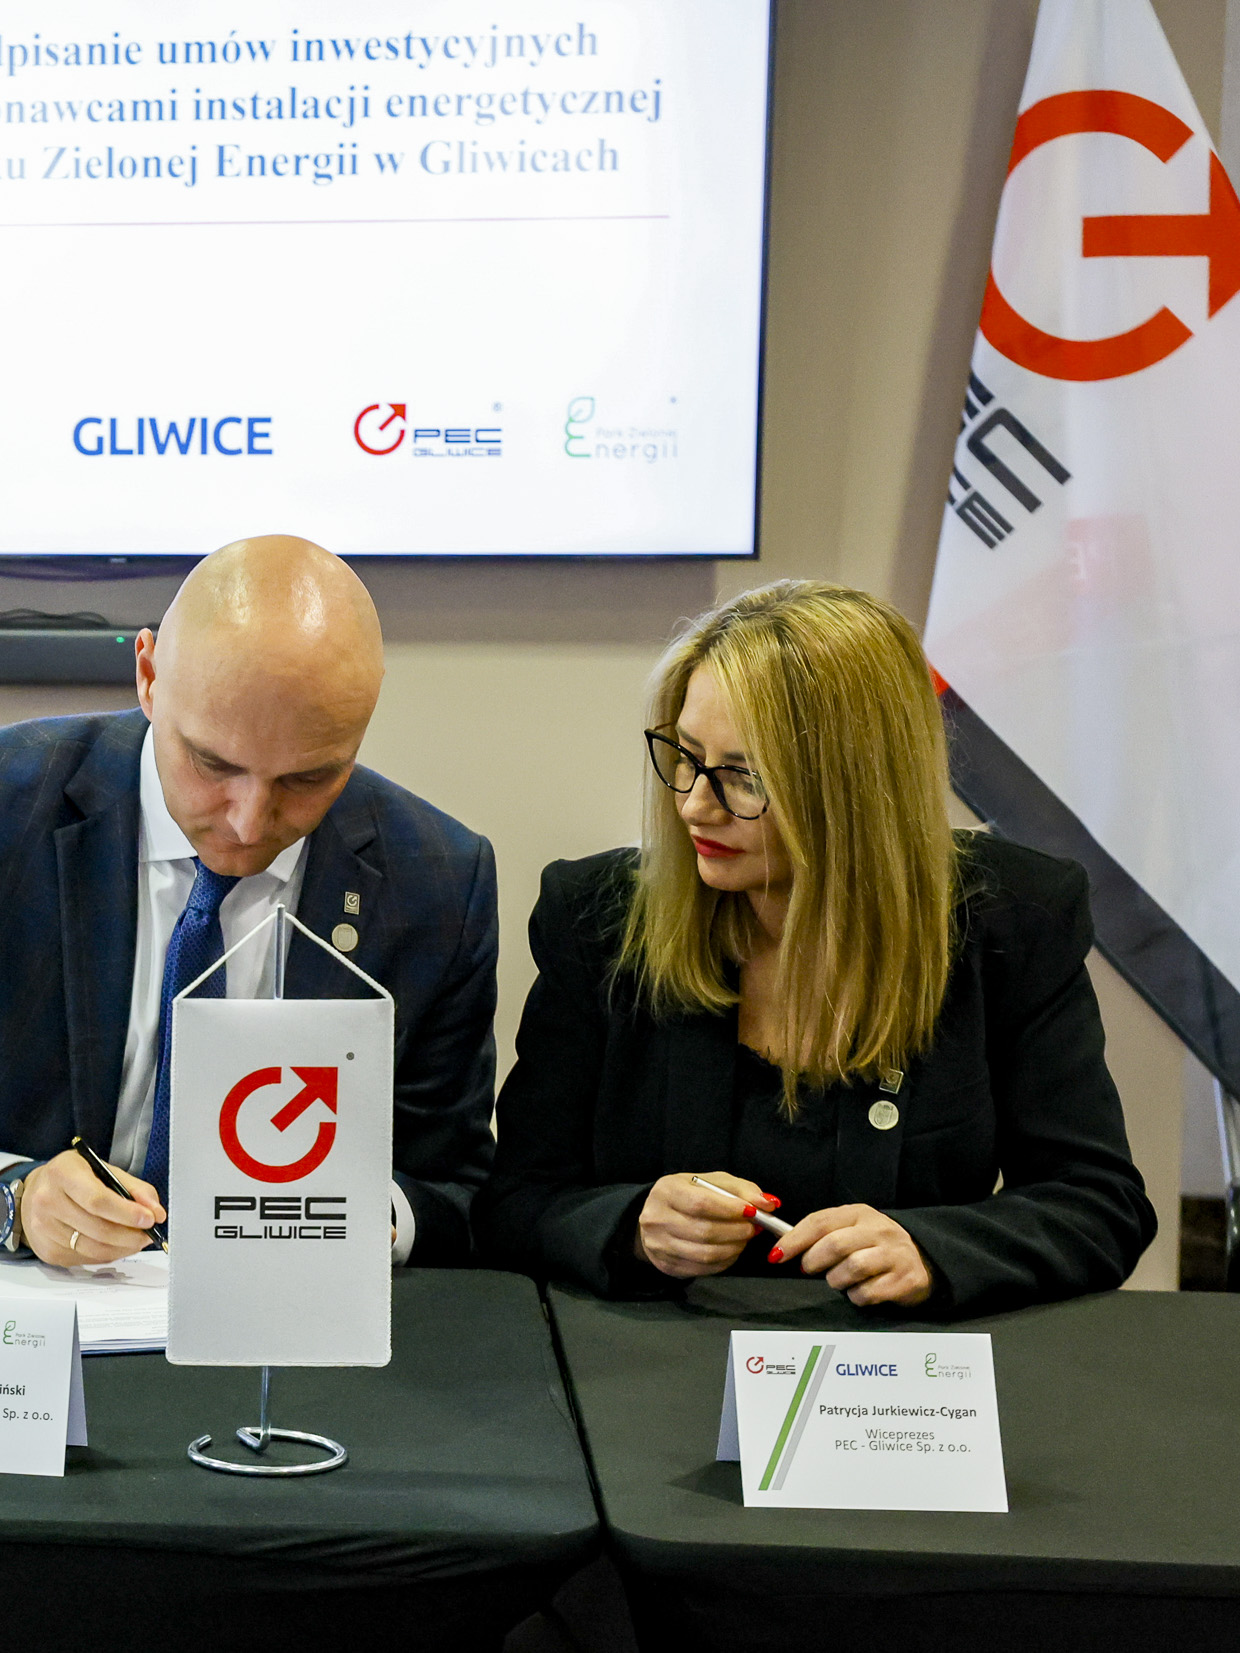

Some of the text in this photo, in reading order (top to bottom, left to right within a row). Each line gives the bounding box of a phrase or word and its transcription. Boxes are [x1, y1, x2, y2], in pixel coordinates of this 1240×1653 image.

[158, 30, 271, 65] umów
[291, 22, 596, 70] inwestycyjnych
[194, 84, 370, 128] instalacji
[385, 78, 662, 125] energetycznej
[43, 144, 197, 187] Zielonej
[217, 142, 358, 185] Energii
[374, 150, 405, 175] w
[418, 137, 619, 175] Gliwicach
[72, 416, 273, 457] GLIWICE
[413, 428, 502, 444] PEC
[213, 1195, 347, 1221] PEC
[214, 1225, 347, 1240] GLIWICE
[835, 1363, 899, 1377] GLIWICE
[2, 1407, 20, 1421] Sp.
[31, 1411, 54, 1421] o.o.
[819, 1404, 977, 1420] Patrycja Jurkiewicz-Cygan
[864, 1428, 935, 1442] Wiceprezes
[835, 1439, 858, 1451] PEC
[868, 1438, 913, 1452] Gliwice
[916, 1440, 935, 1454] Sp.
[947, 1443, 971, 1453] o.o.
